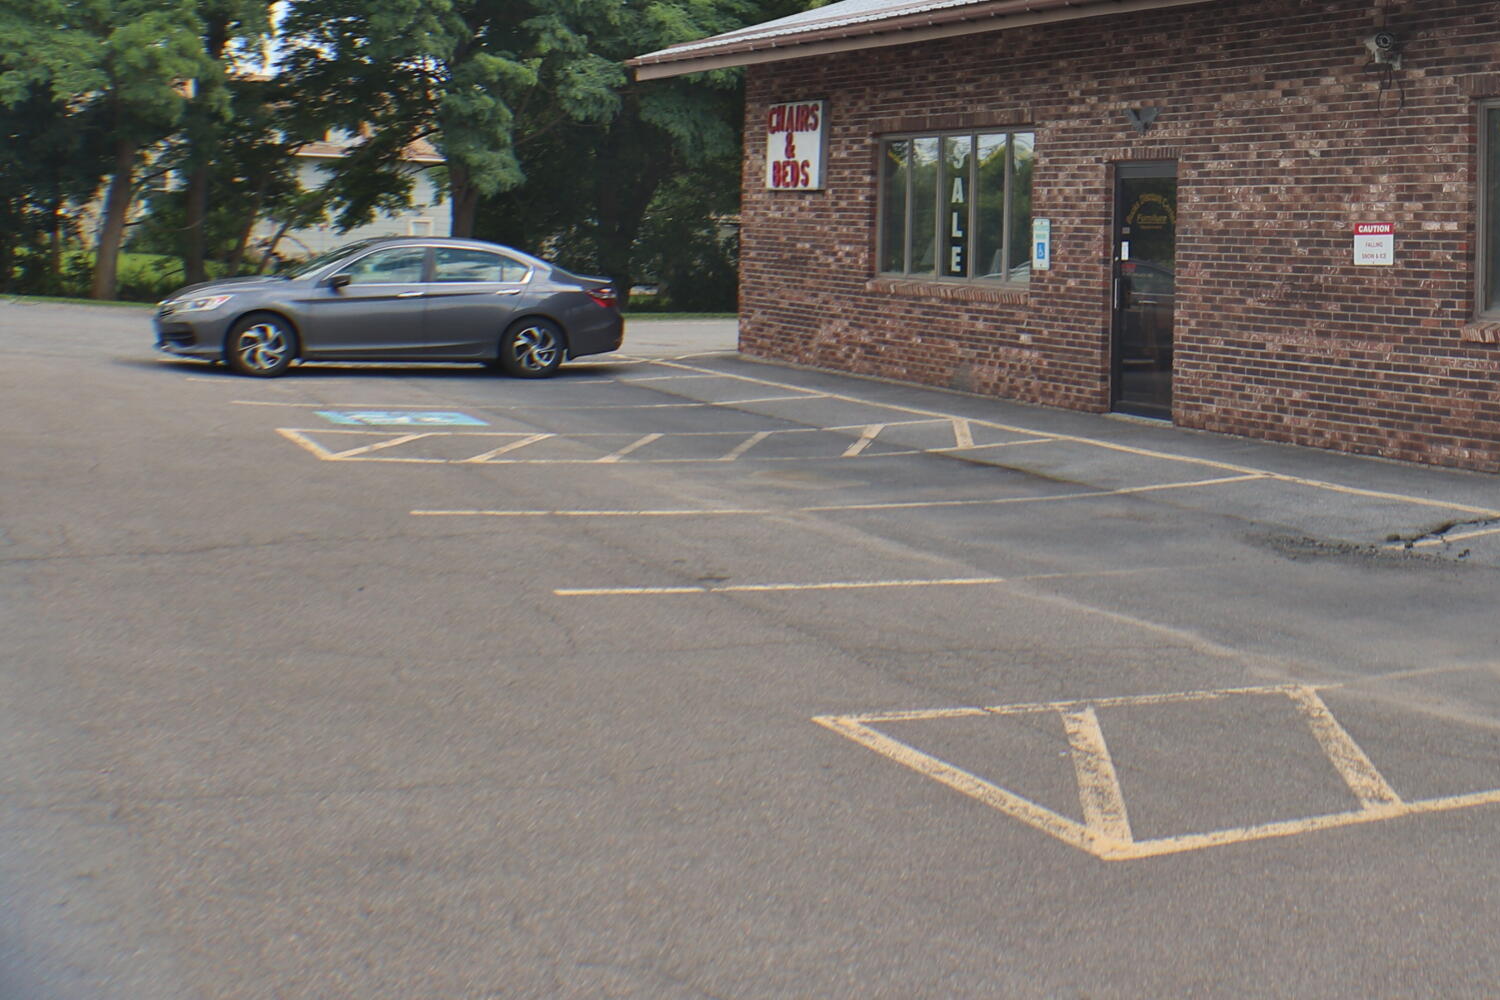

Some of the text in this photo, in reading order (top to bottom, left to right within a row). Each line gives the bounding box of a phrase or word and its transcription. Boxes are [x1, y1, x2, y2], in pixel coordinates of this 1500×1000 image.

[768, 103, 819, 134] CHAIRS
[785, 132, 796, 159] &
[772, 160, 810, 188] BEDS
[951, 143, 966, 272] SALE
[1358, 224, 1390, 233] CAUTION
